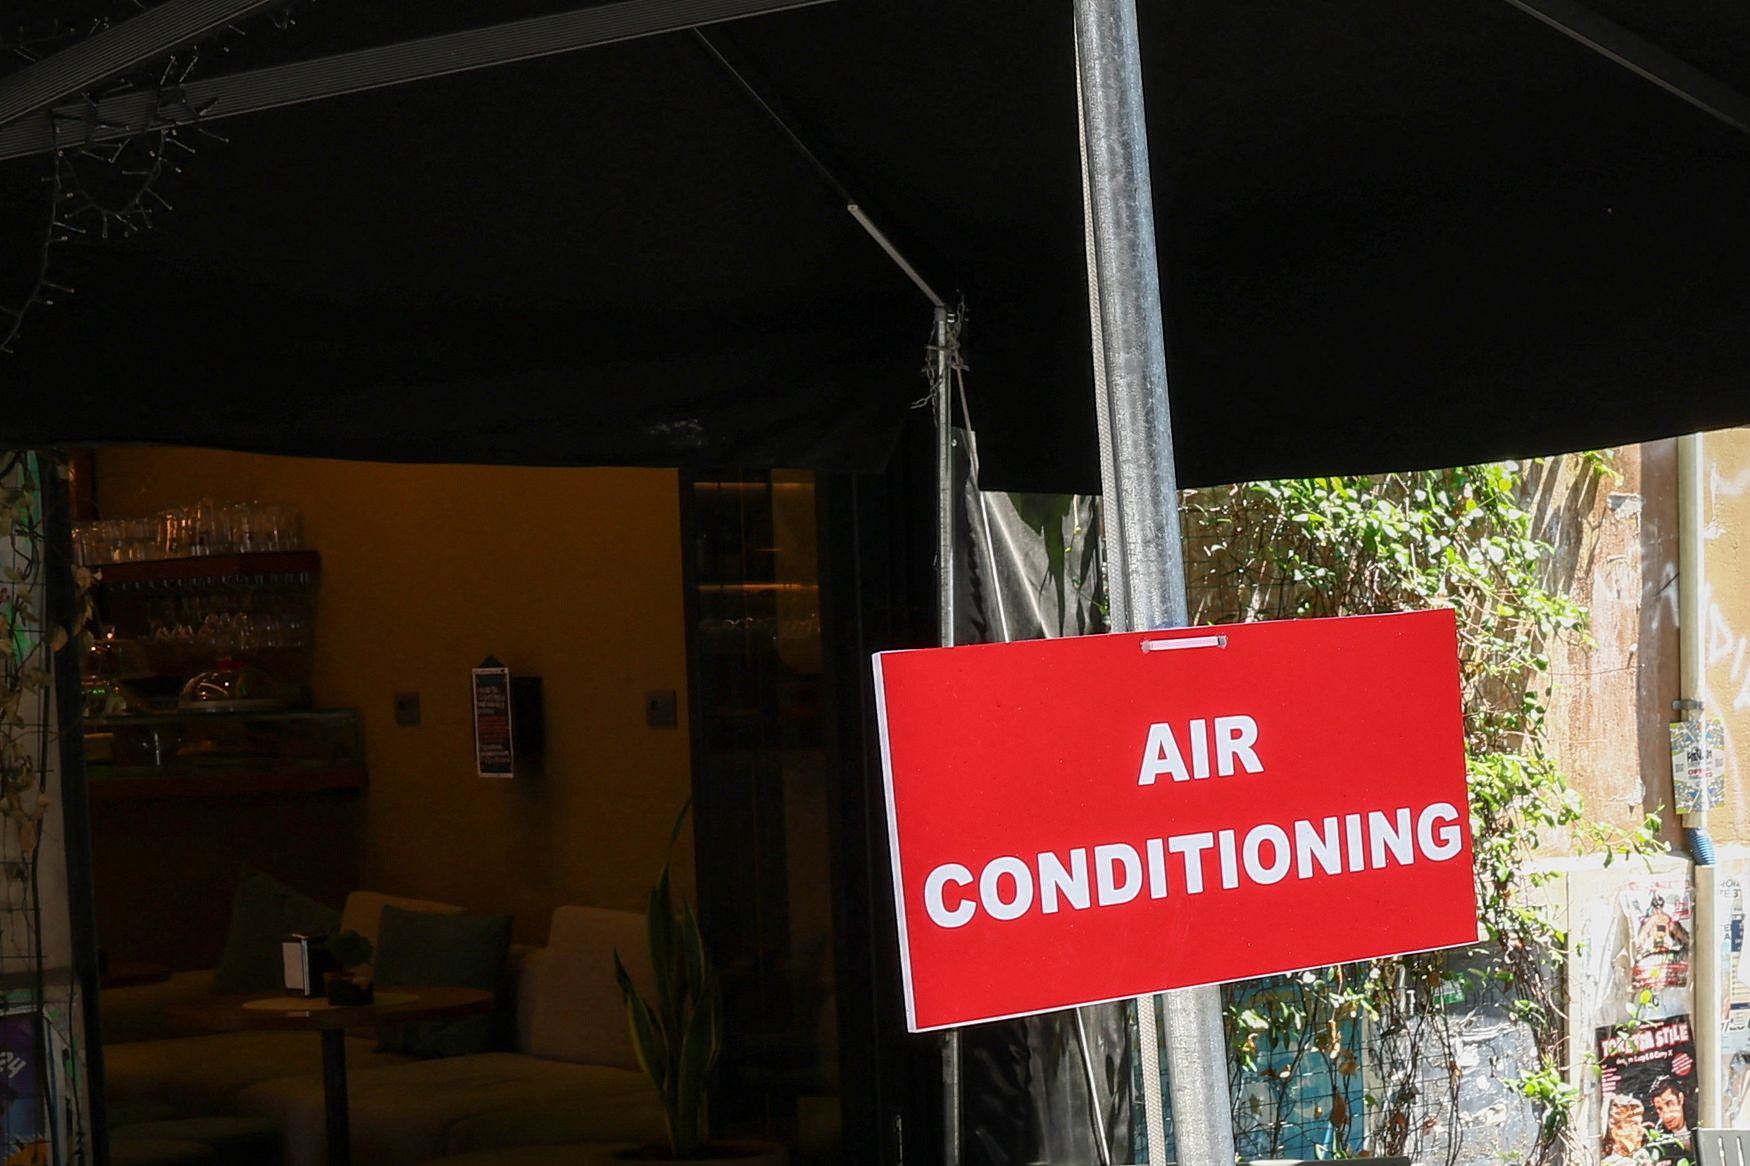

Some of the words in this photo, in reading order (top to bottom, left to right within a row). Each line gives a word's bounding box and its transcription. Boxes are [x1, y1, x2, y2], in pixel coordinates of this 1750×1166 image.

[1137, 714, 1265, 786] AIR
[923, 801, 1463, 929] CONDITIONING
[1655, 1023, 1689, 1048] STILE
